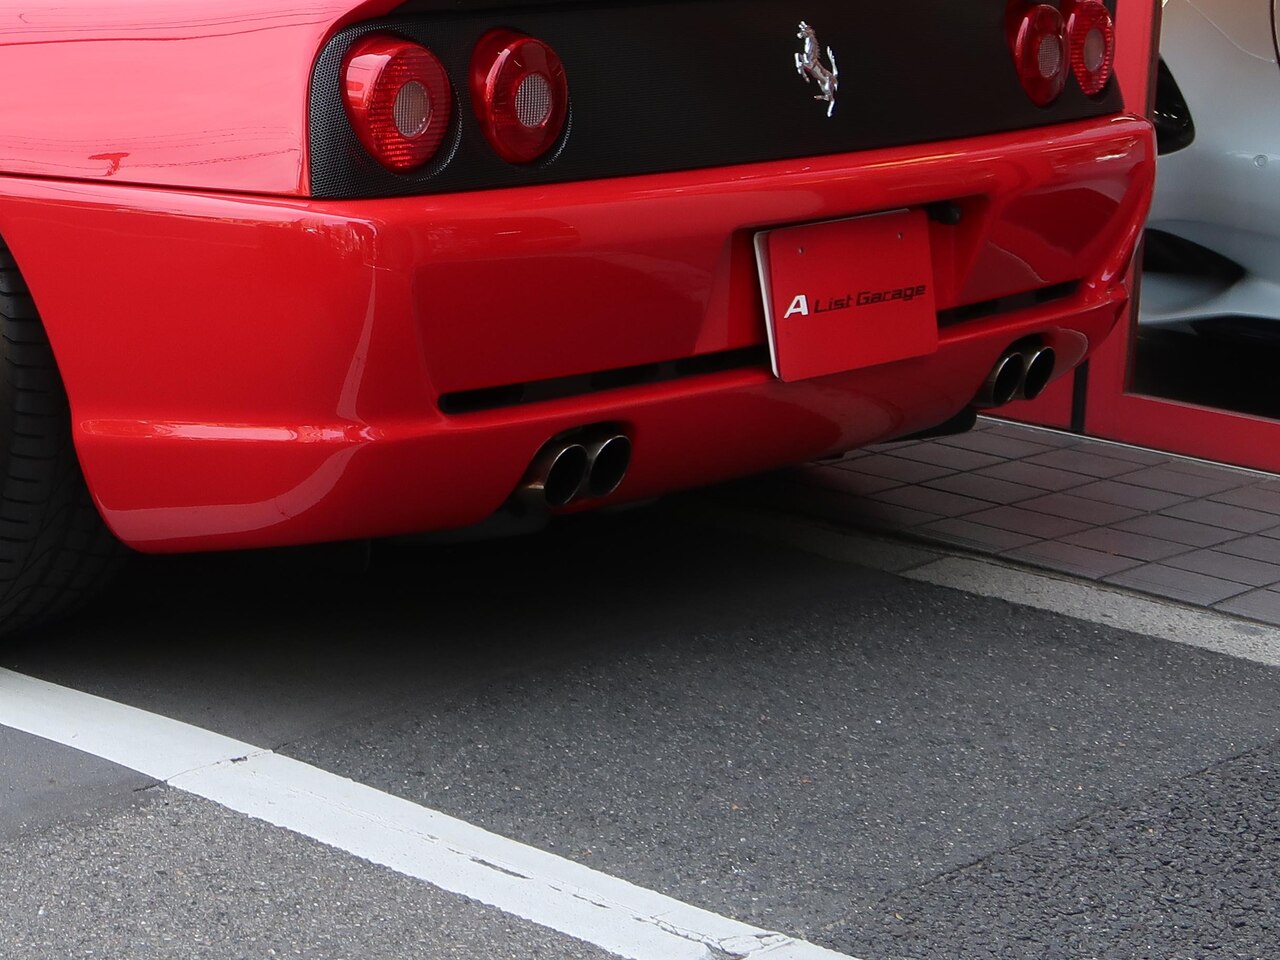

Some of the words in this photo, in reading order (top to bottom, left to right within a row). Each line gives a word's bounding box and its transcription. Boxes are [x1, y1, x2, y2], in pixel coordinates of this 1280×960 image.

[783, 294, 809, 319] A
[814, 295, 853, 314] List
[856, 284, 927, 307] Garage
